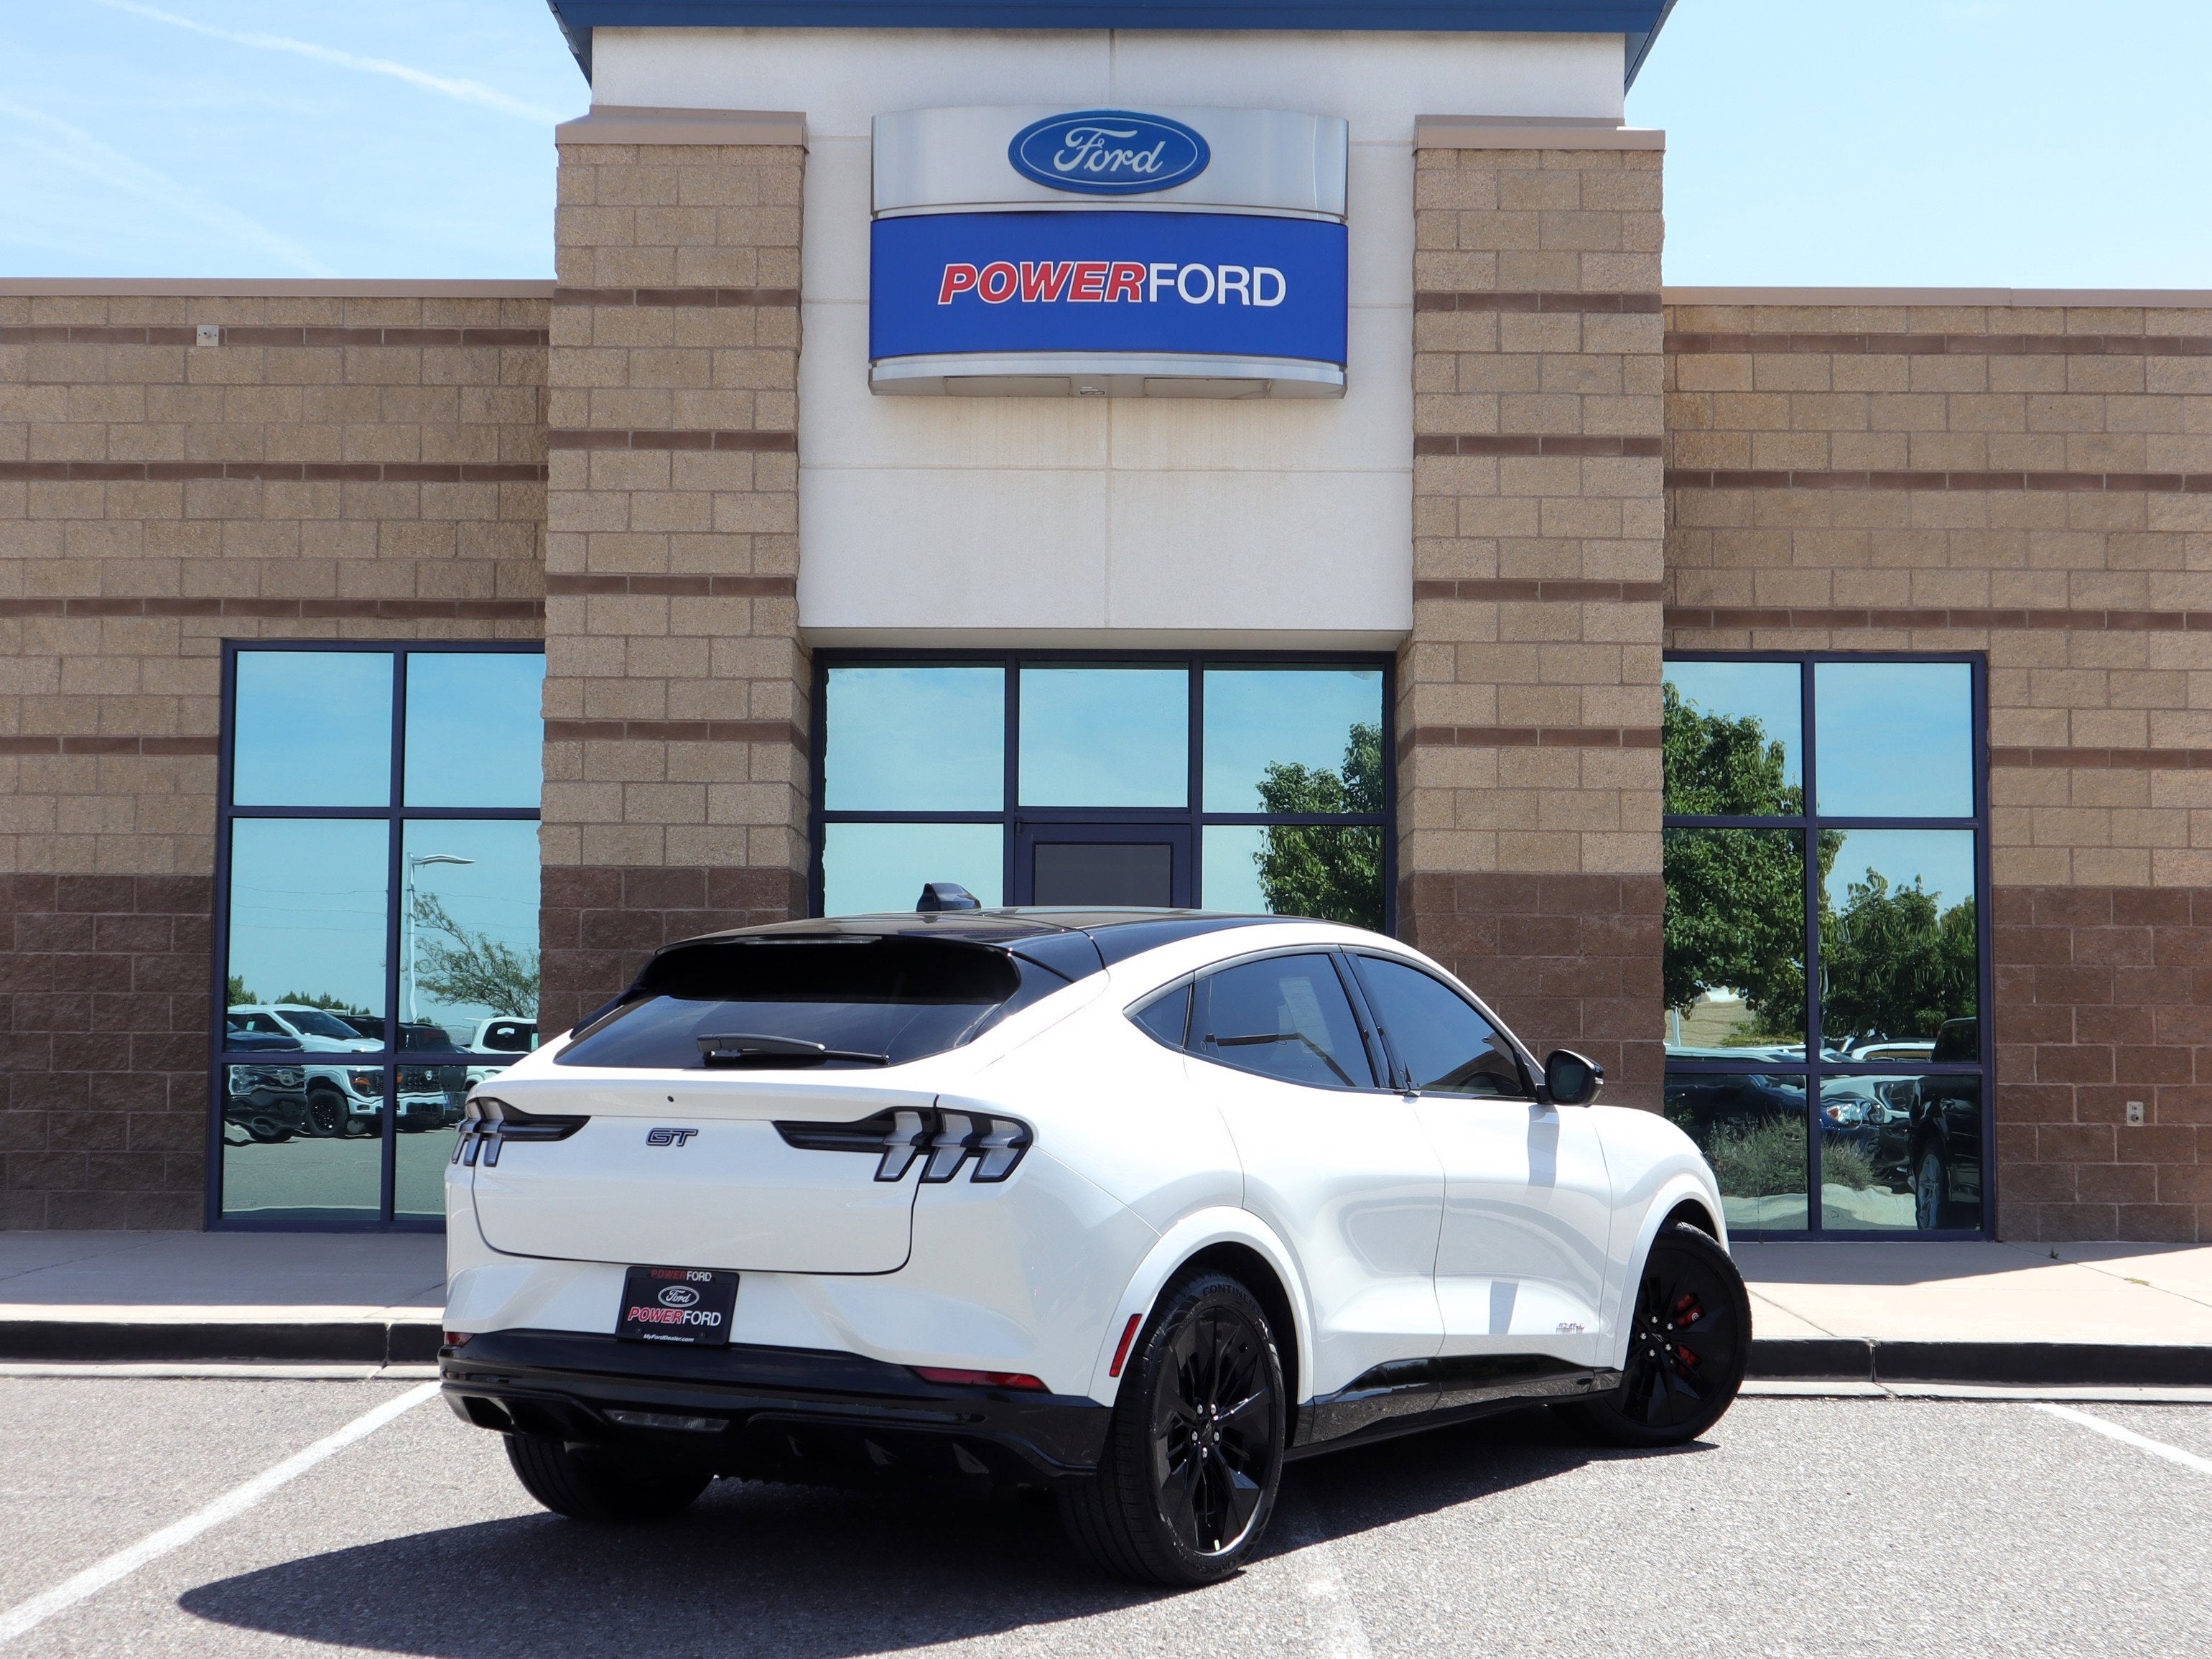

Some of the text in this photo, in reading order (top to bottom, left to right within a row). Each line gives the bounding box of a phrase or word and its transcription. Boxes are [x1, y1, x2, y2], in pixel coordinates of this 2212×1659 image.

[1054, 127, 1166, 173] Ford
[646, 1128, 699, 1147] GT
[666, 1290, 691, 1304] Ford
[643, 1334, 694, 1342] MyFordDealer.com
